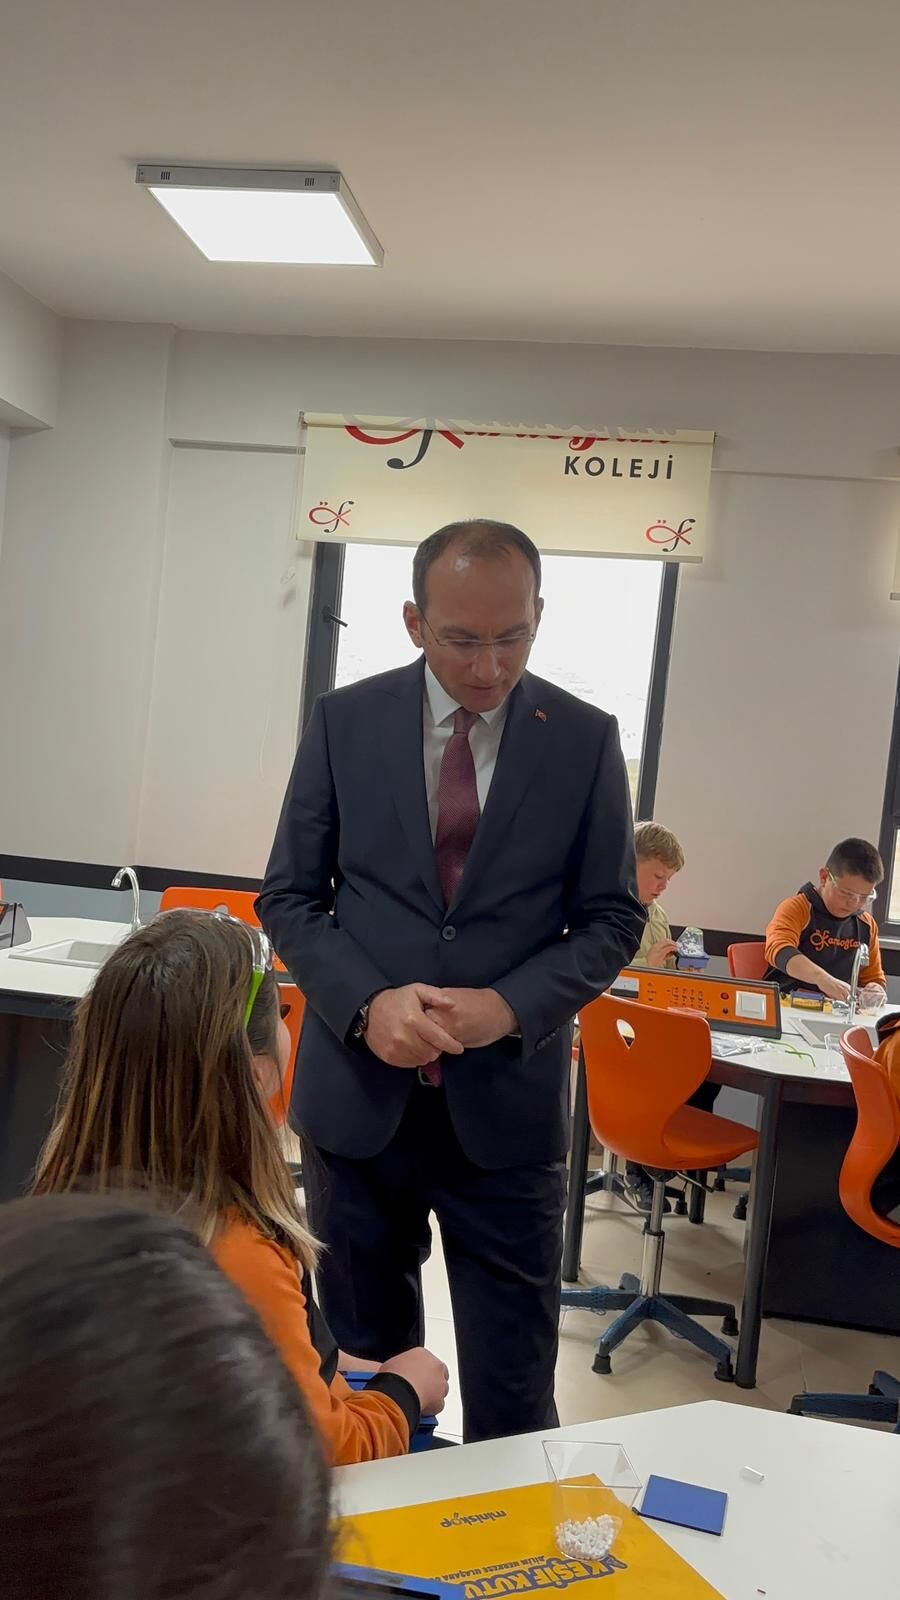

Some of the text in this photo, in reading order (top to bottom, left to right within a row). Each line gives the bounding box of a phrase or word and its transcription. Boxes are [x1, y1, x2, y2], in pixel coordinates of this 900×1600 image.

[564, 455, 673, 479] KOLEJİ
[440, 1510, 507, 1527] miniskop
[536, 1558, 609, 1586] KEŞİF
